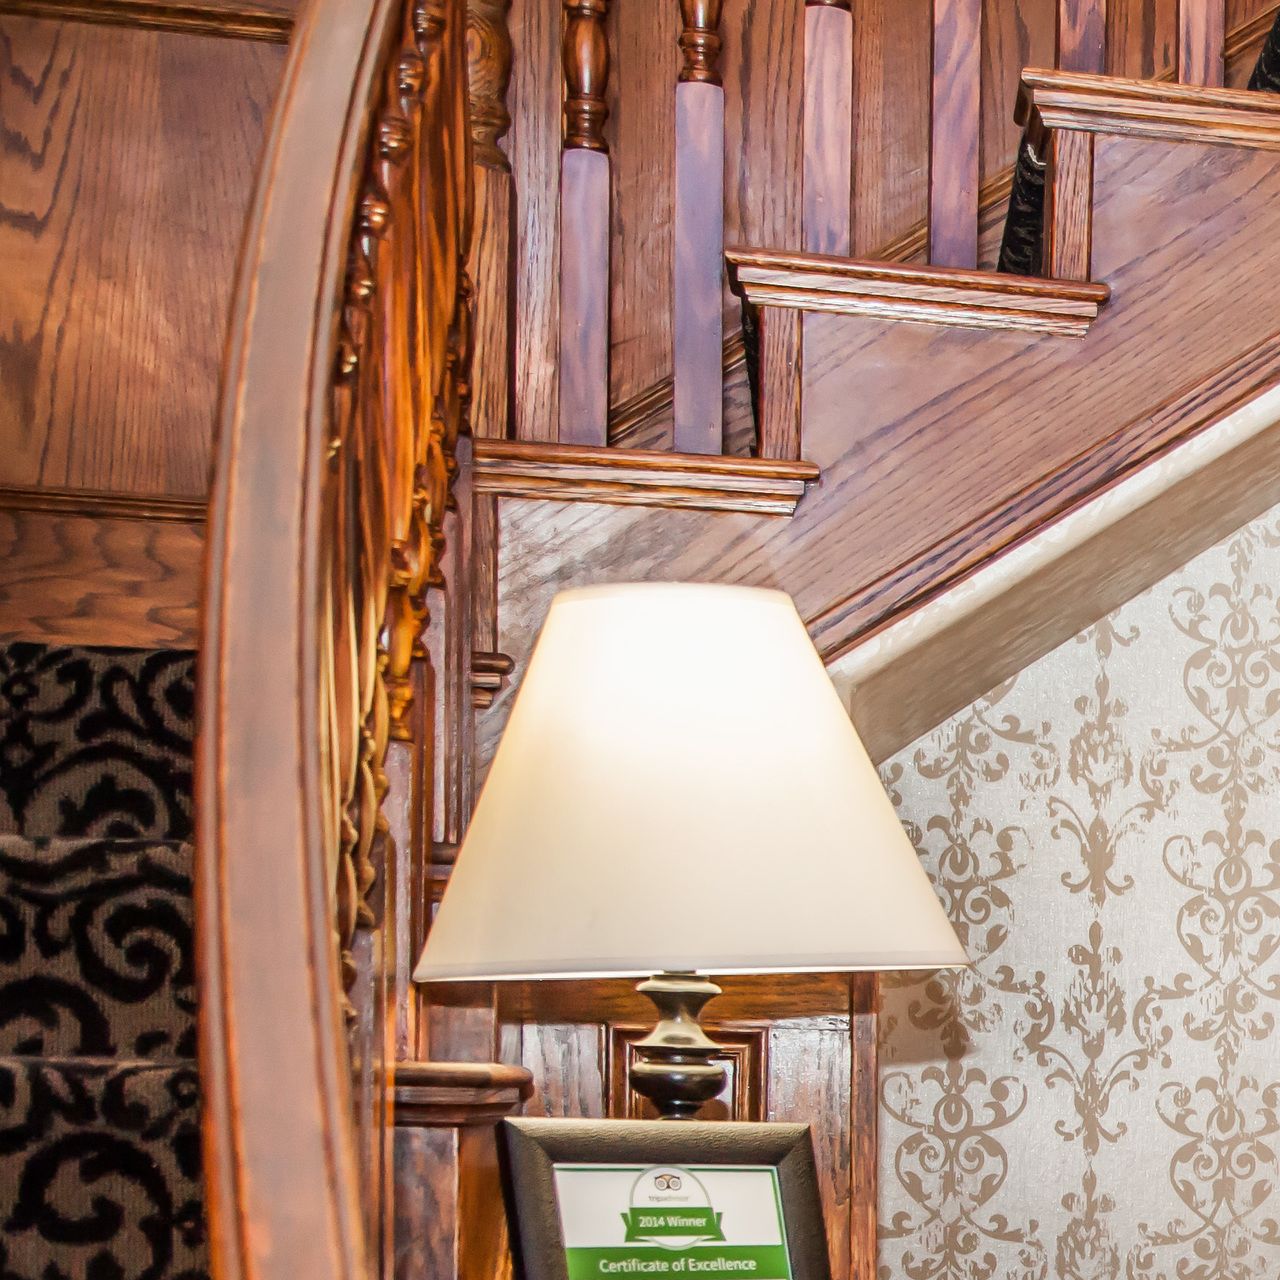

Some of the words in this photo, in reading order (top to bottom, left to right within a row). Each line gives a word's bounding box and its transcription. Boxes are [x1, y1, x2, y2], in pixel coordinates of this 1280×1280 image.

[639, 1216, 665, 1228] 2014
[667, 1216, 707, 1227] Winner
[599, 1259, 669, 1273] Certificate
[672, 1258, 685, 1272] of
[688, 1257, 757, 1272] Excellence
